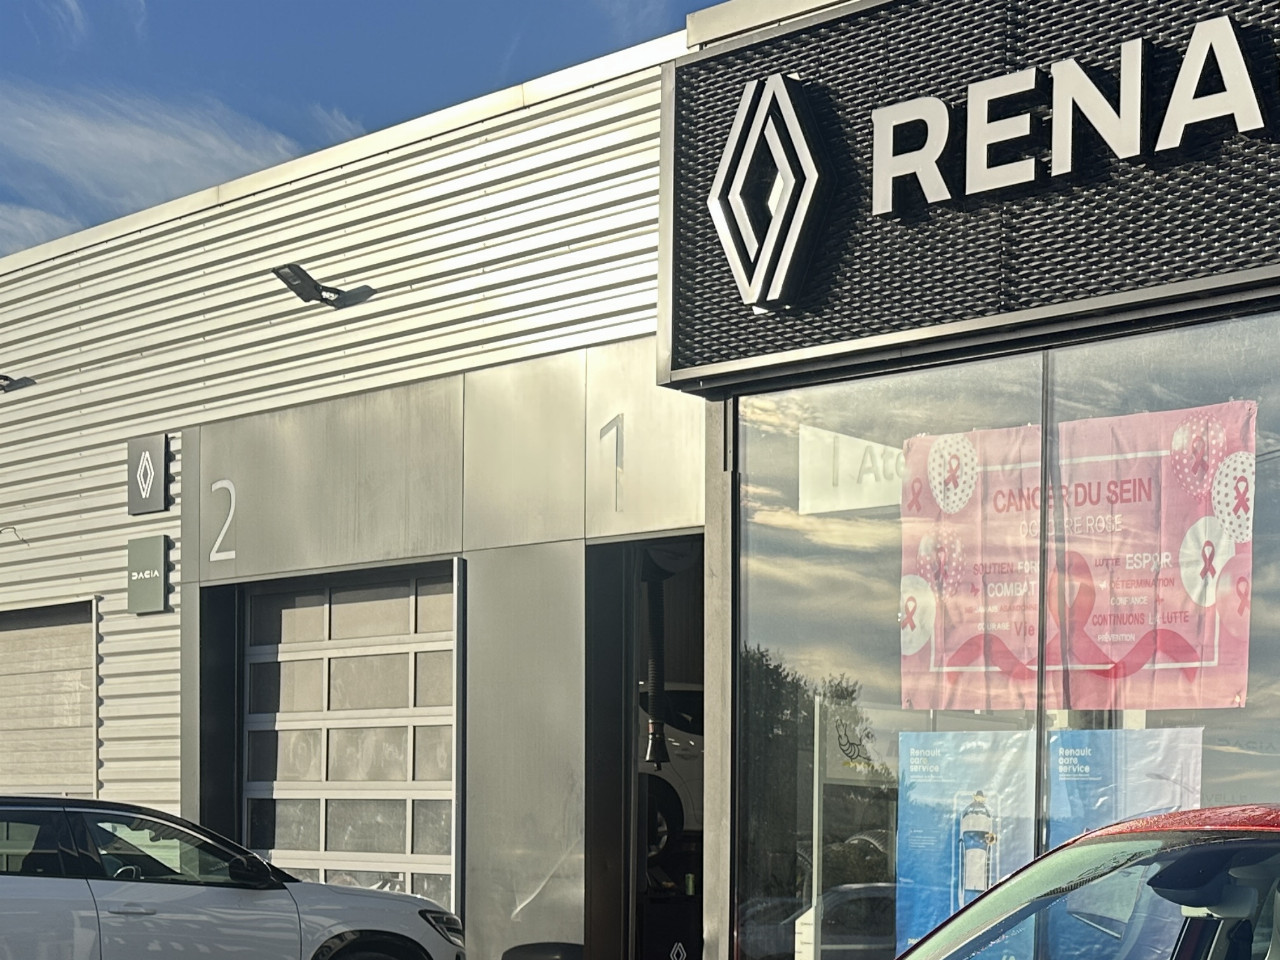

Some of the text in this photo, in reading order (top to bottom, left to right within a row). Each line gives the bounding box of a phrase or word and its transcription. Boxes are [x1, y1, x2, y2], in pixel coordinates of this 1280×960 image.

[599, 412, 624, 512] 1
[1074, 481, 1101, 507] DU
[1107, 477, 1152, 505] SEIN
[209, 478, 236, 562] 2
[1086, 513, 1123, 534] ROSE
[973, 562, 1014, 575] SOUTIEN
[1125, 551, 1172, 570] ESPOIR
[131, 569, 160, 580] DACIA
[987, 580, 1037, 598] COMBAT
[1092, 613, 1145, 626] CONTINUONS
[1162, 610, 1189, 624] LUTTE
[1013, 621, 1035, 637] Vie
[910, 747, 941, 757] Renault
[1058, 747, 1092, 757] Renault
